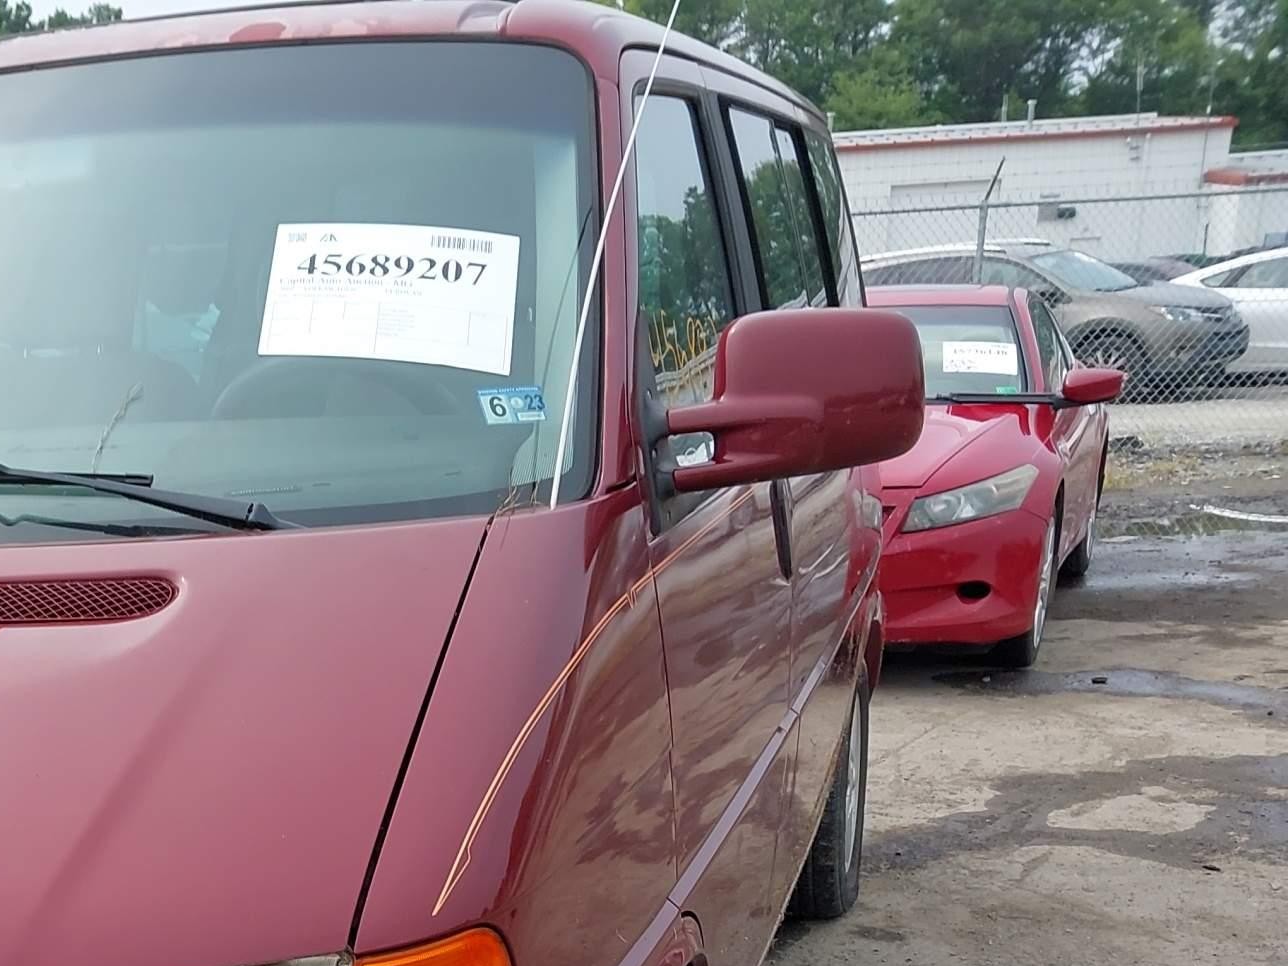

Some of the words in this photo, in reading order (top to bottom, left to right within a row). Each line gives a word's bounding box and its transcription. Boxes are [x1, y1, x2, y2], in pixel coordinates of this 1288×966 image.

[297, 252, 488, 287] 45689207
[488, 396, 508, 417] 6
[524, 394, 546, 411] 23
